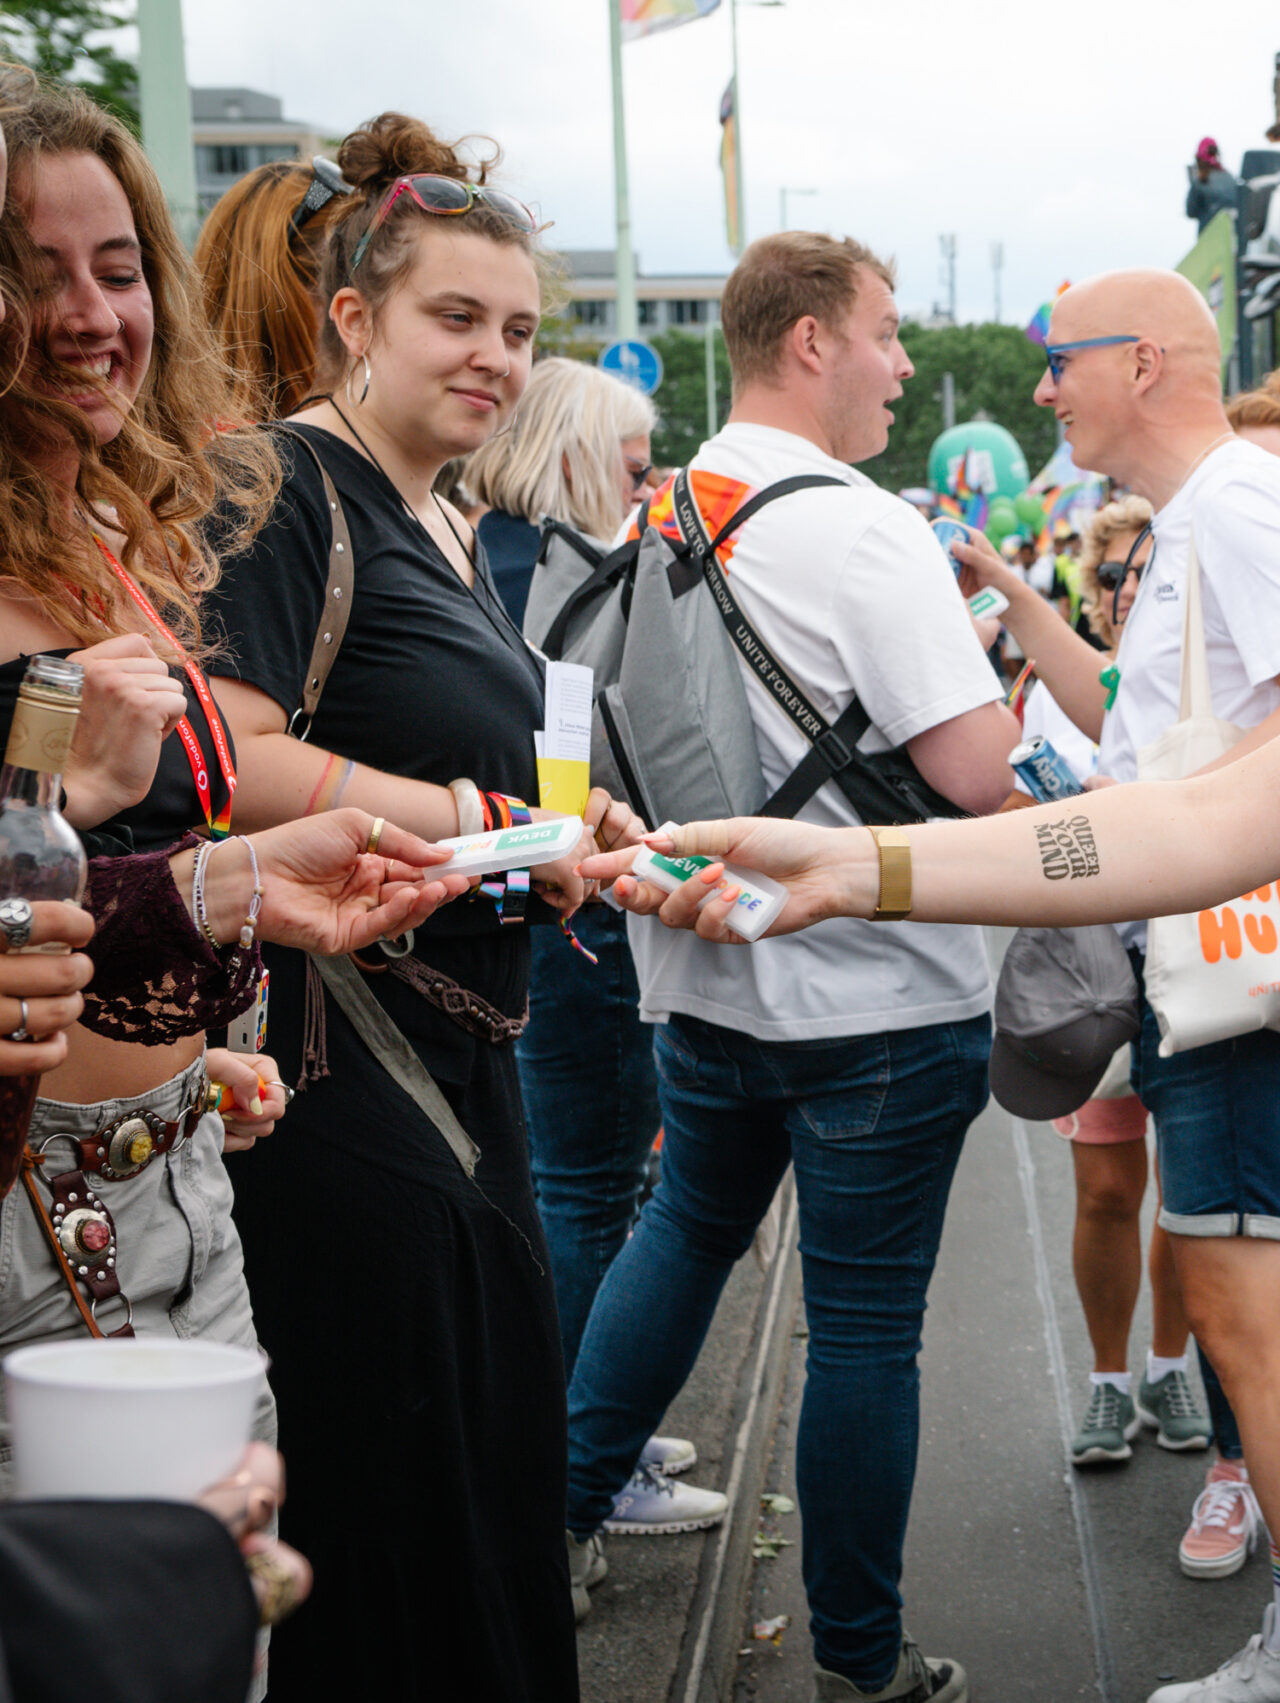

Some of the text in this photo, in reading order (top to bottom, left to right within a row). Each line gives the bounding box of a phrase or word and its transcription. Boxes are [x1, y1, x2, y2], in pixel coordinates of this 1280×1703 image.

[680, 501, 698, 539] LOVE
[736, 624, 822, 737] UNITE FOREVER
[178, 719, 202, 769] vodafon
[211, 718, 231, 774] vodafone
[508, 829, 552, 844] DEVK
[1033, 822, 1070, 880] MIND
[1050, 818, 1087, 880] YOUR
[1066, 815, 1100, 878] QUEER
